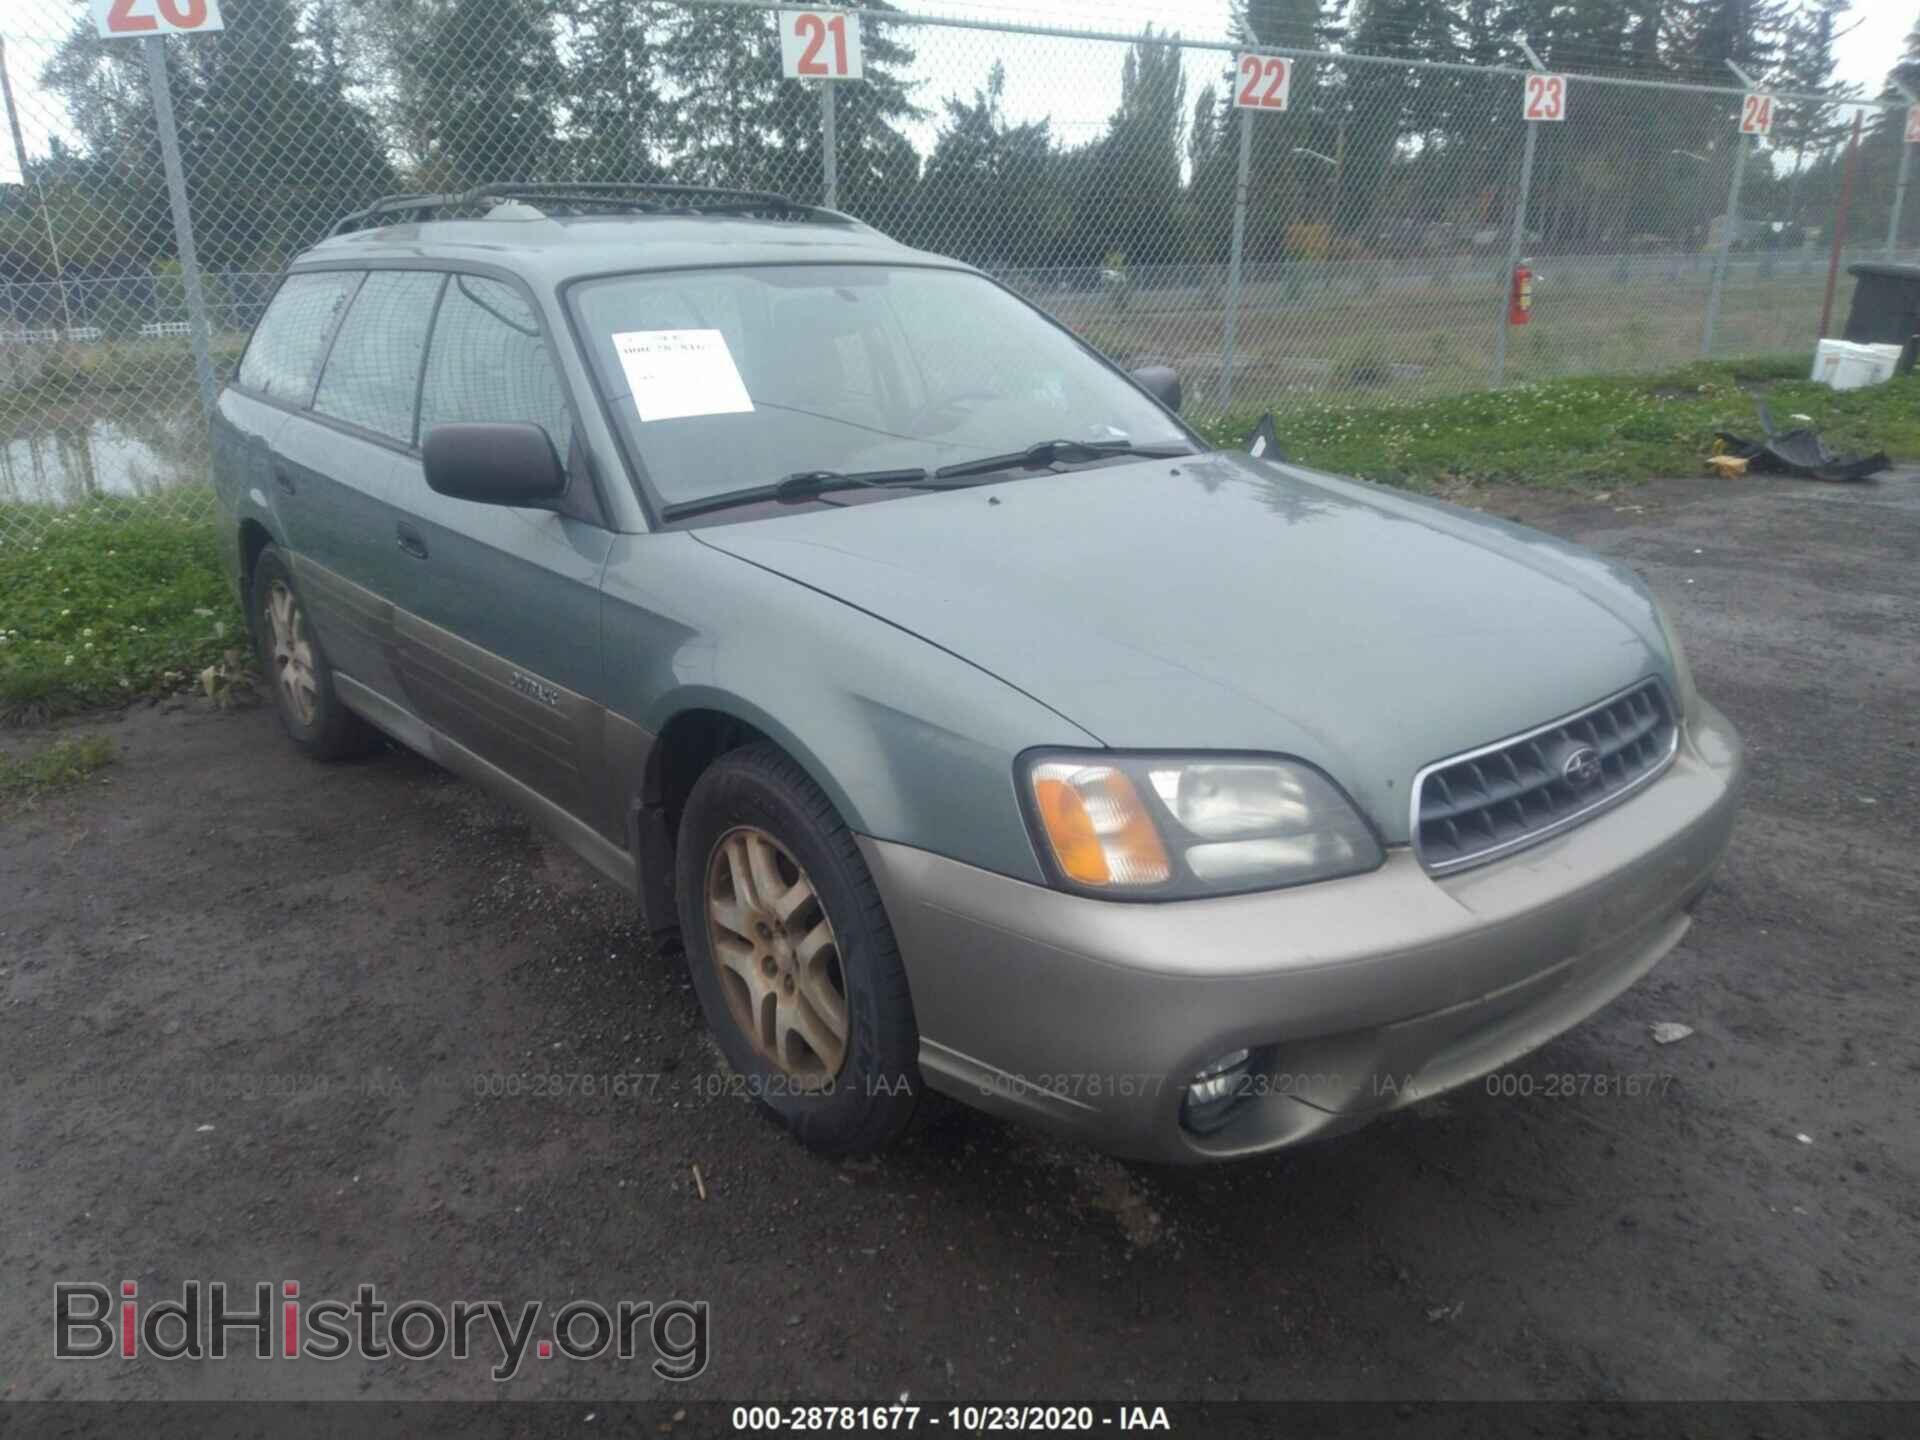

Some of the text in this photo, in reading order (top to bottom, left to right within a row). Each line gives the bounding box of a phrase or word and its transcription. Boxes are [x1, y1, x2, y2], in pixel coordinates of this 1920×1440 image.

[795, 13, 848, 75] 21
[1239, 56, 1285, 107] 22
[1527, 78, 1562, 118] 23
[1743, 96, 1771, 132] 24
